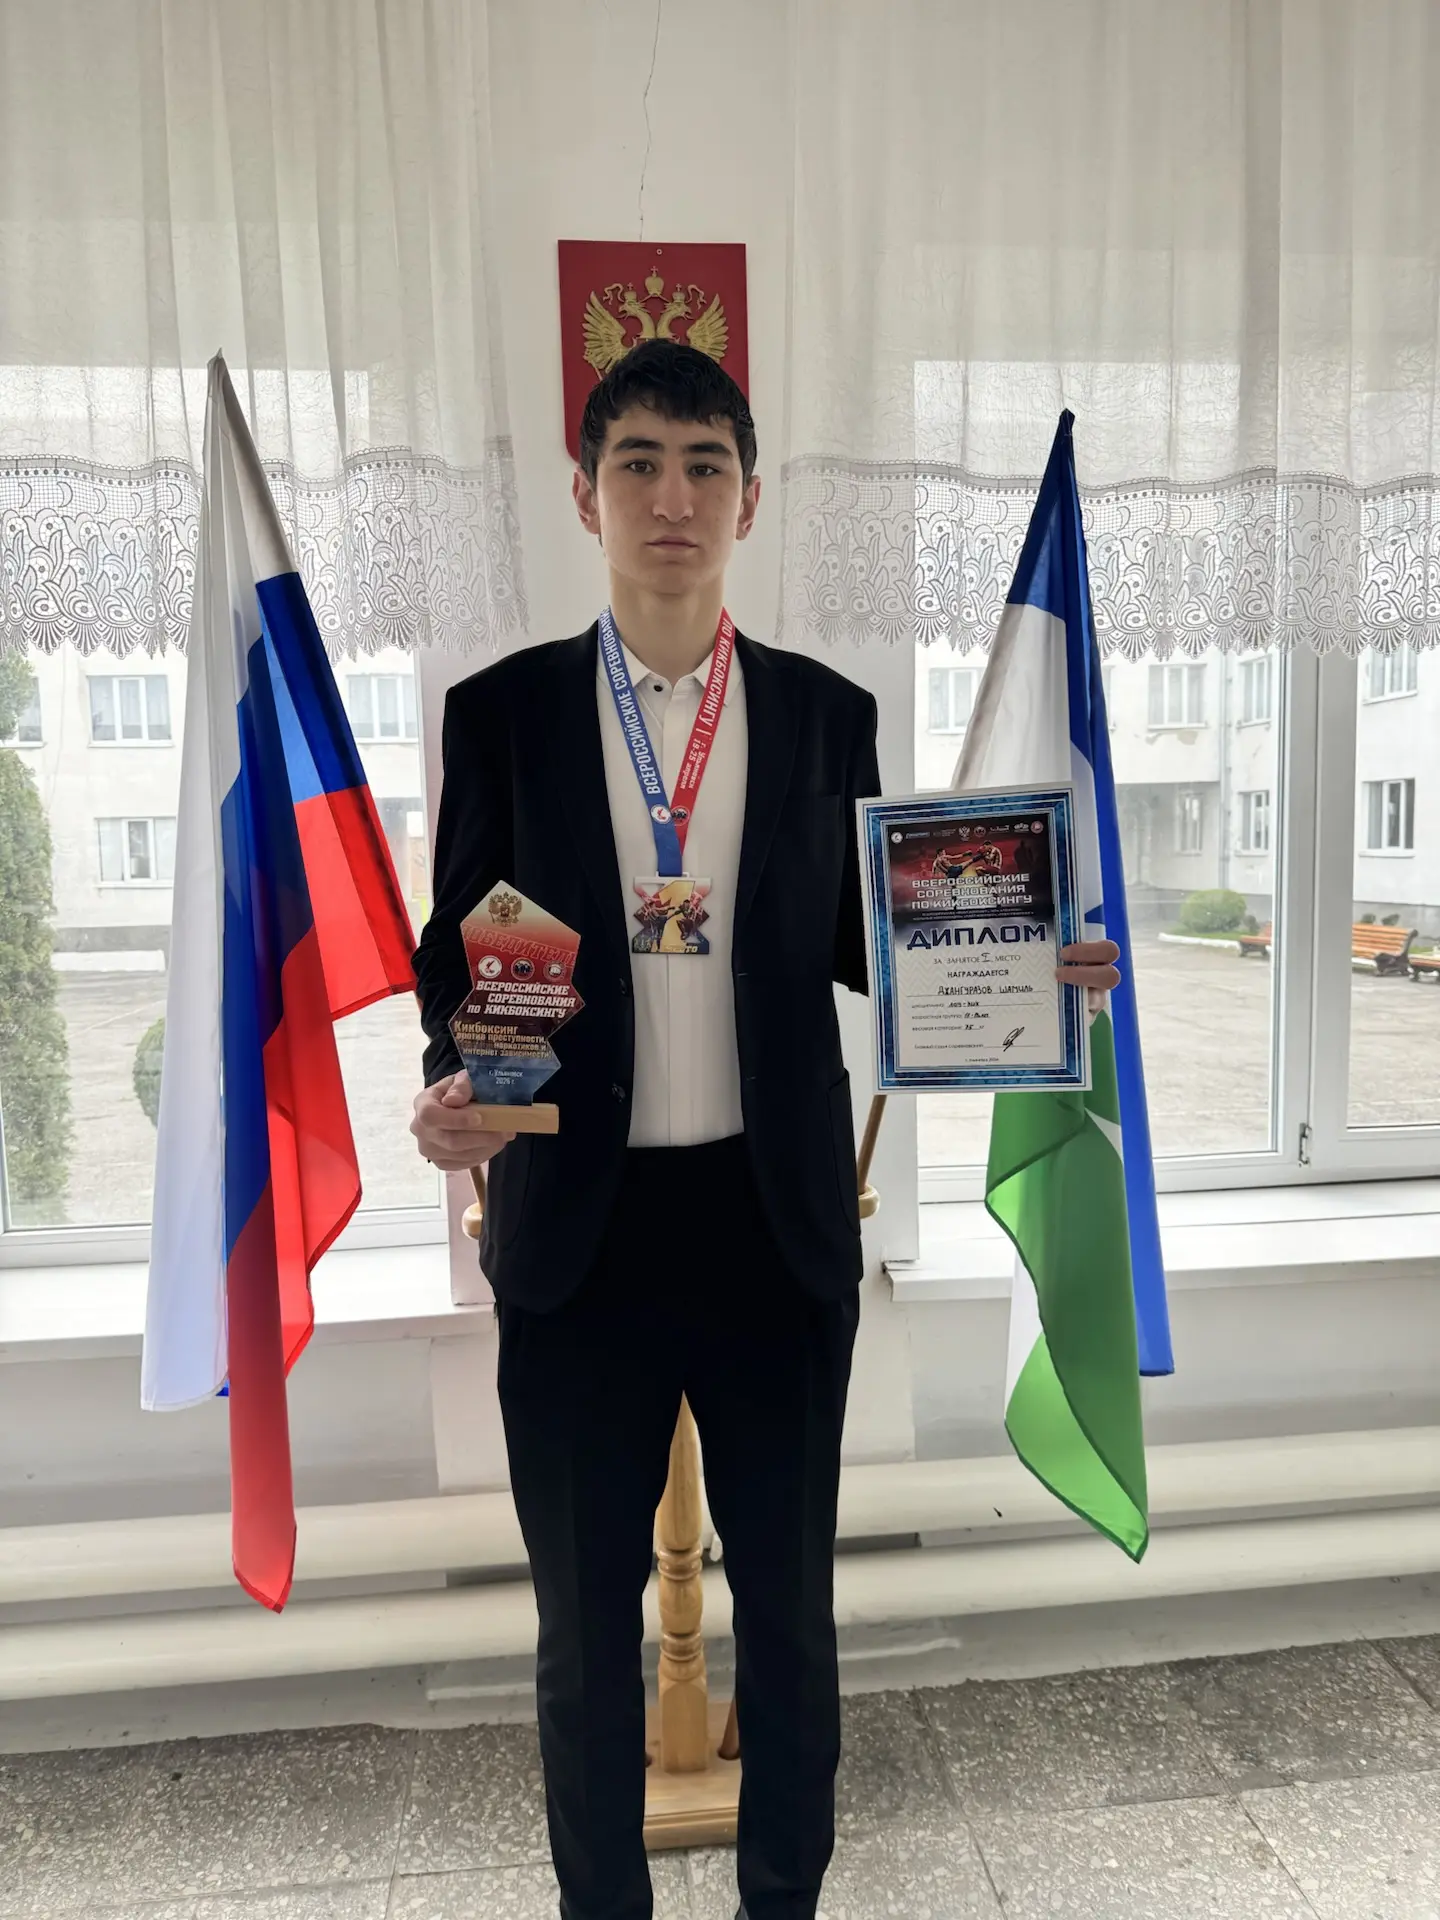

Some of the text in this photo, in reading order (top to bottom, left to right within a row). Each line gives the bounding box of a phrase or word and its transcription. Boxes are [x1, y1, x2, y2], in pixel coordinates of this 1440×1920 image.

[721, 617, 733, 637] ПО
[699, 637, 731, 727] КИКБОКСИНГУ
[617, 689, 661, 795] ВСЕРОССИЙСКИЕ
[911, 872, 1030, 889] ВСЕРОССИЙСКИЕ
[916, 884, 1026, 899] СОРЕВНОВАНИЯ
[911, 894, 1033, 910] ПО КИКБОКСИНГУ
[906, 923, 1047, 950] ДИПЛОМ
[947, 956, 980, 964] ЗАНЯТОЕ
[995, 954, 1021, 962] МЕСТО
[947, 969, 1009, 978] НАГРАЖДАЕТСЯ
[476, 980, 570, 996] ВСЕРОССИЙСКИЕ
[487, 993, 576, 1008] СОРЕВНОВАНИЯ
[484, 1004, 567, 1018] КИКБОКСИНГУ
[454, 1020, 518, 1034] Кикбоксинг
[456, 1032, 486, 1041] против
[463, 1047, 498, 1057] интернет
[494, 1042, 538, 1051] наркотиков
